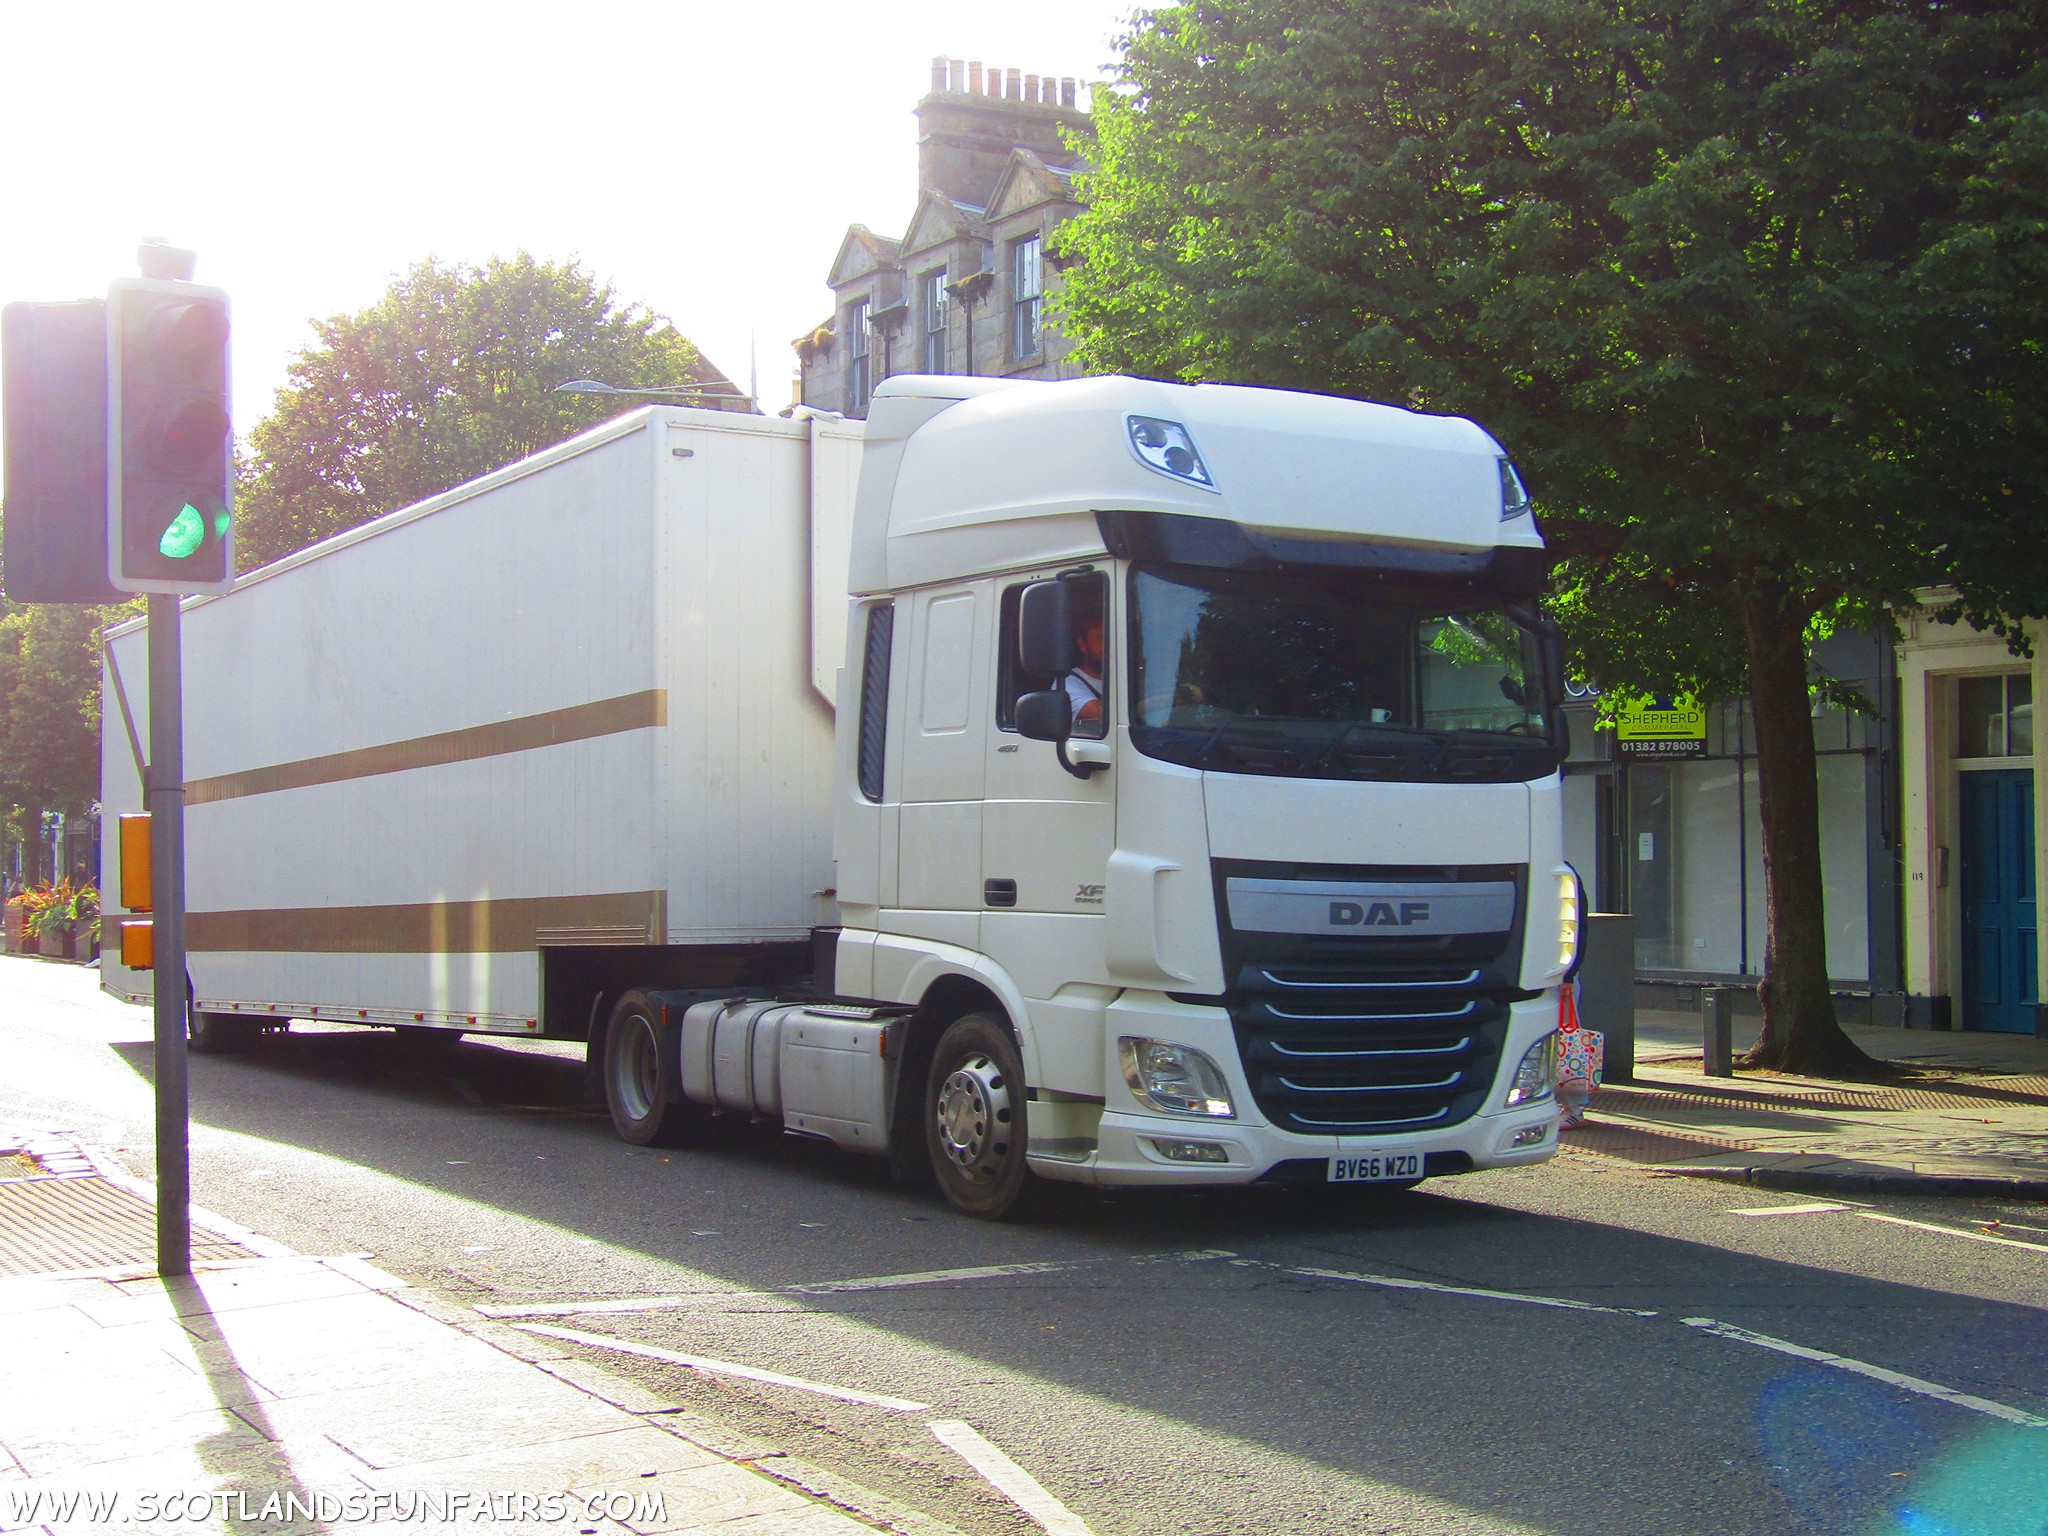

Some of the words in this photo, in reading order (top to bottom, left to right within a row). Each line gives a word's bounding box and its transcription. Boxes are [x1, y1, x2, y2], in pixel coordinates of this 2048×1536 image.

[1622, 711, 1699, 725] SHEPHERD
[1621, 742, 1656, 751] 01382
[1658, 741, 1700, 751] 878005
[1076, 884, 1105, 896] XF
[1329, 902, 1429, 926] DAF
[1335, 1158, 1380, 1180] BV66
[1385, 1155, 1418, 1176] WZD
